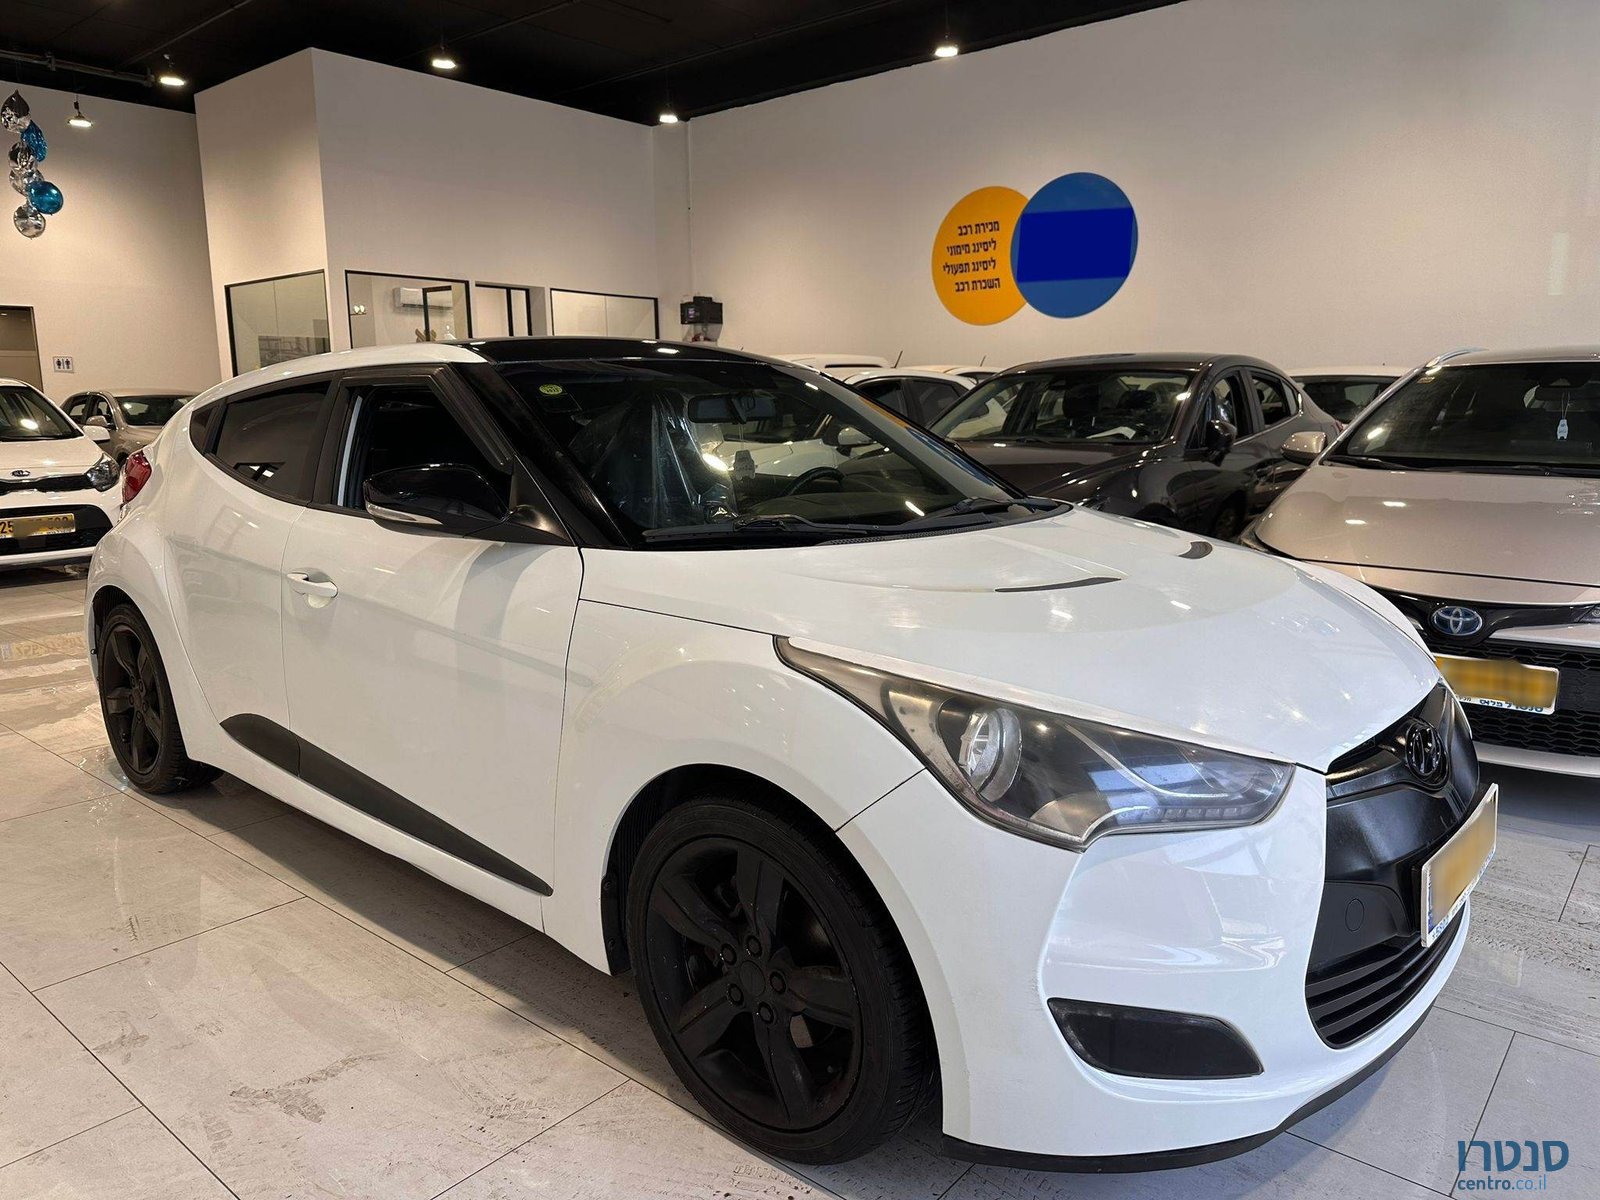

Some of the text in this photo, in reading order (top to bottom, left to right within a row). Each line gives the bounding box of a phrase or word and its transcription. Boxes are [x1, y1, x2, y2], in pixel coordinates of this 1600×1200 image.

[958, 220, 999, 236] מכירת רכב
[946, 238, 996, 256] ליסינג מימוני
[942, 257, 996, 276] ליסינג תפעולי
[955, 277, 1001, 293] השכרת רכב
